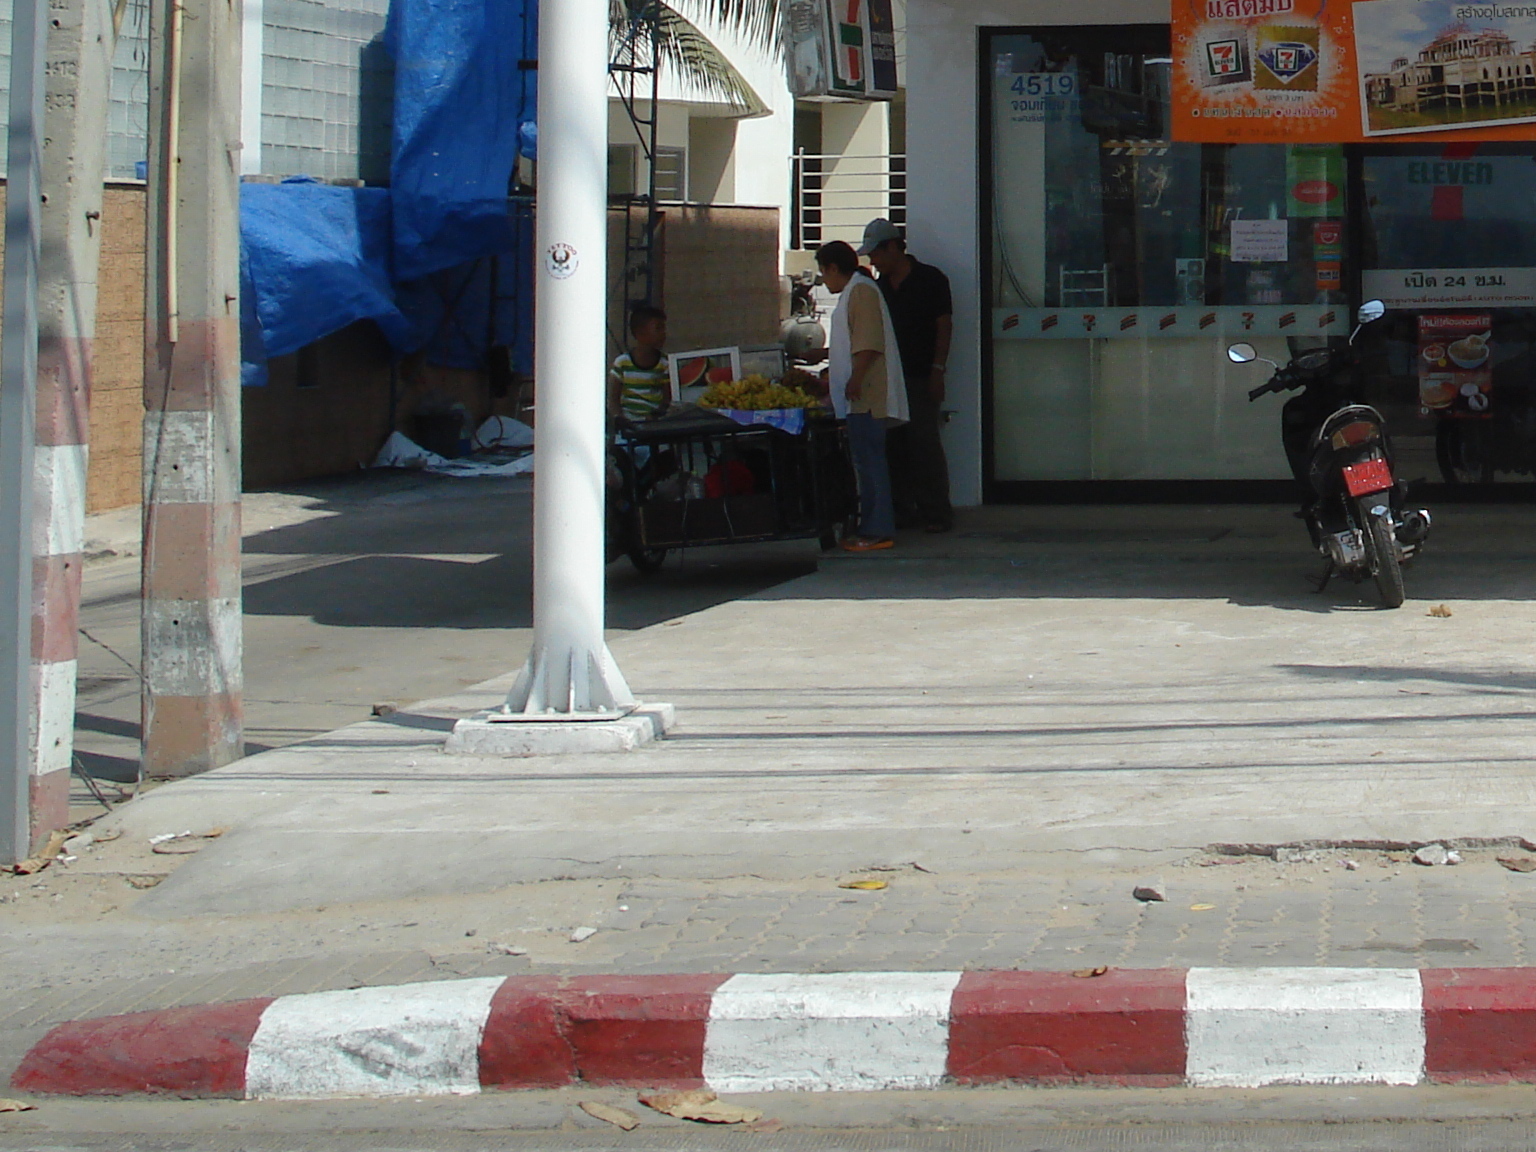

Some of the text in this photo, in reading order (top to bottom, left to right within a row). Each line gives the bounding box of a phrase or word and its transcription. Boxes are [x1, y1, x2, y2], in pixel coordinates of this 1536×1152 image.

[1011, 75, 1074, 95] 4519
[1404, 272, 1437, 288] เปิด
[1444, 276, 1466, 287] 24
